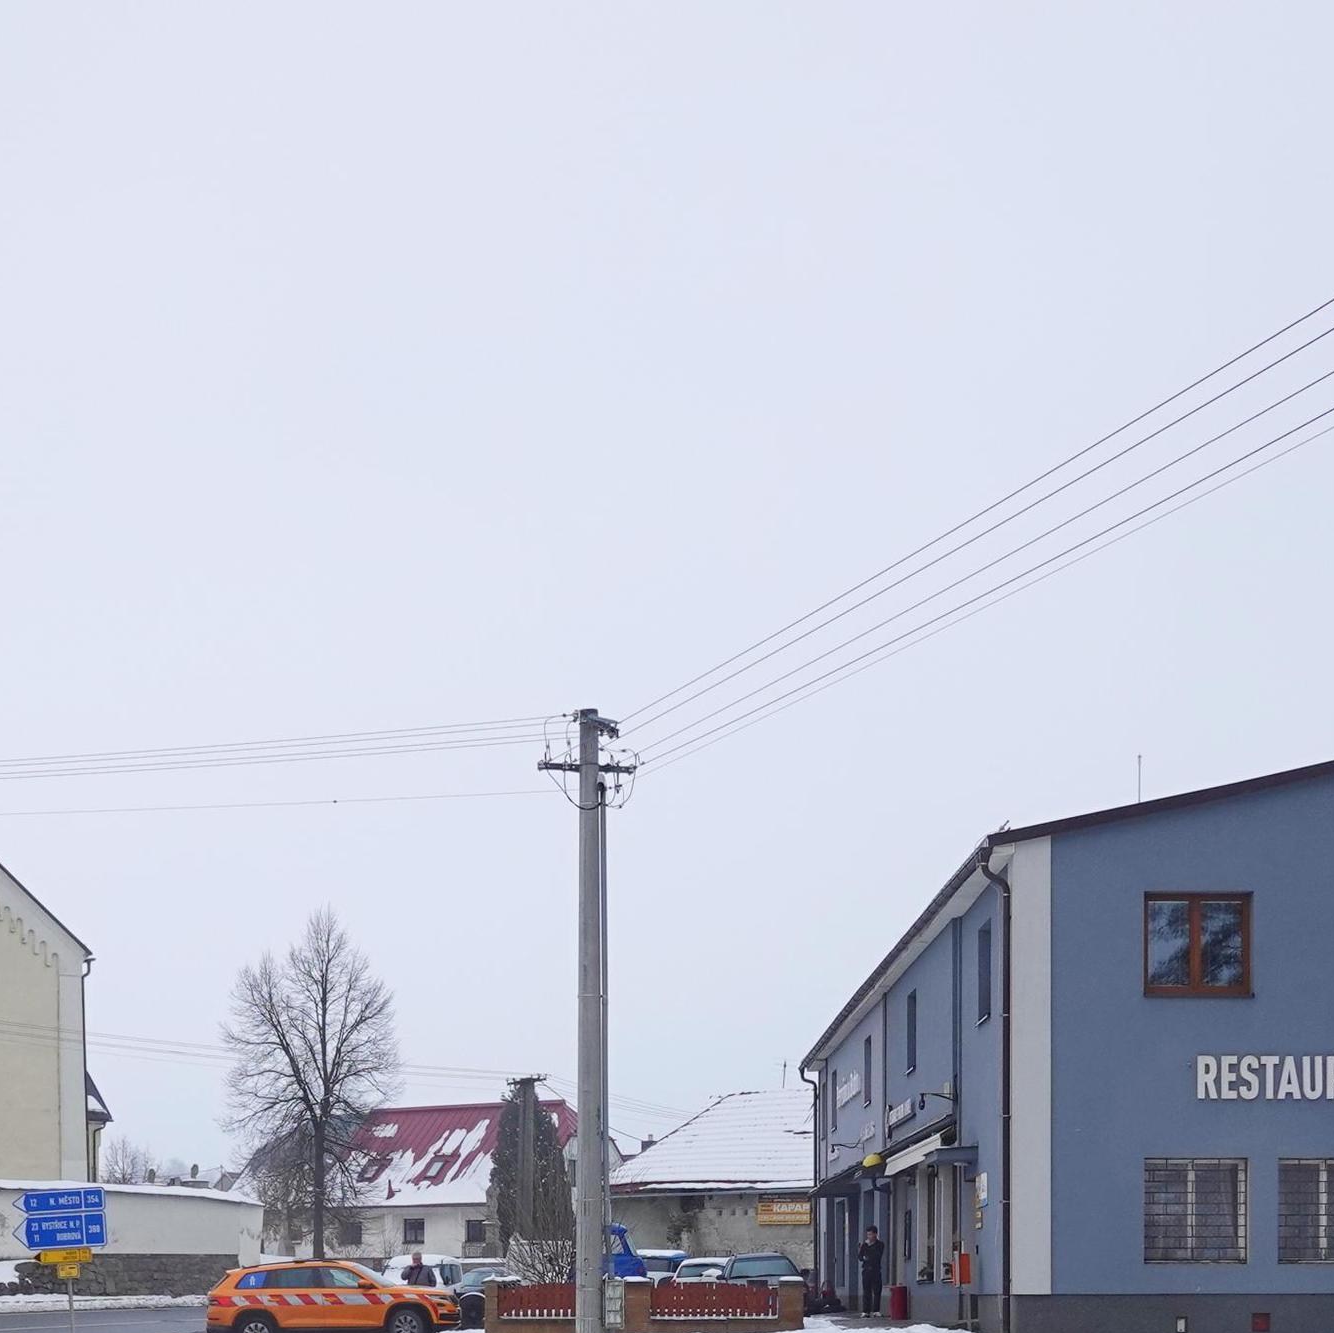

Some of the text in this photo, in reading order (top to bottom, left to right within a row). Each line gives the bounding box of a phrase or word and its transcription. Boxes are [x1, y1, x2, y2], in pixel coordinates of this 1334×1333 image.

[30, 1195, 99, 1207] 12 N. MĚSTO 354
[31, 1222, 39, 1231] 23
[42, 1220, 67, 1230] BYSTŘICE
[34, 1234, 40, 1242] 11
